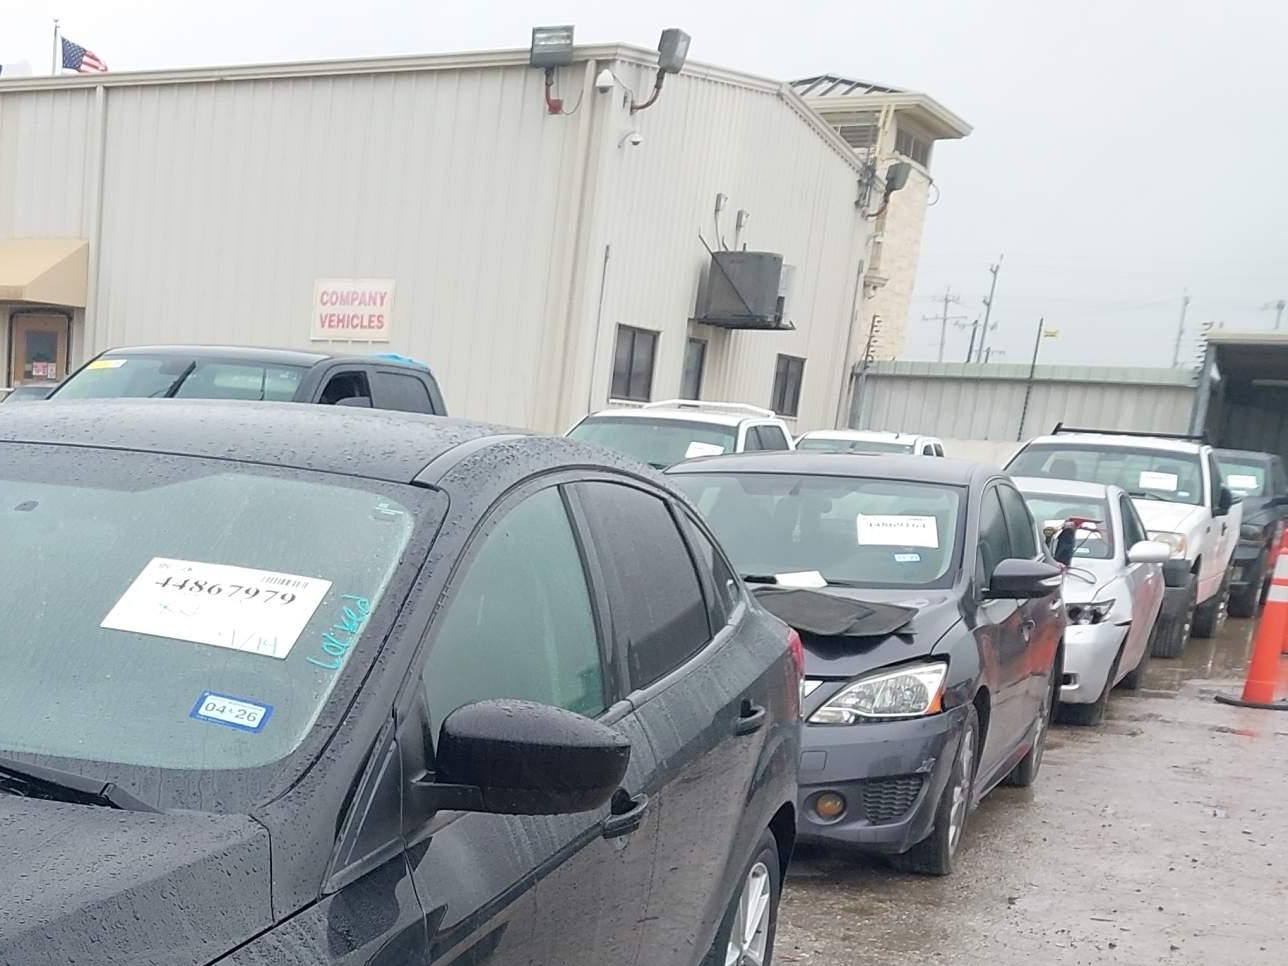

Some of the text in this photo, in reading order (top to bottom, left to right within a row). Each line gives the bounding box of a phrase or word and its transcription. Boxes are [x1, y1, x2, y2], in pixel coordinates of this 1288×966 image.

[320, 290, 388, 306] COMPANY
[320, 313, 384, 329] VEHICLES
[155, 576, 297, 605] 44867979
